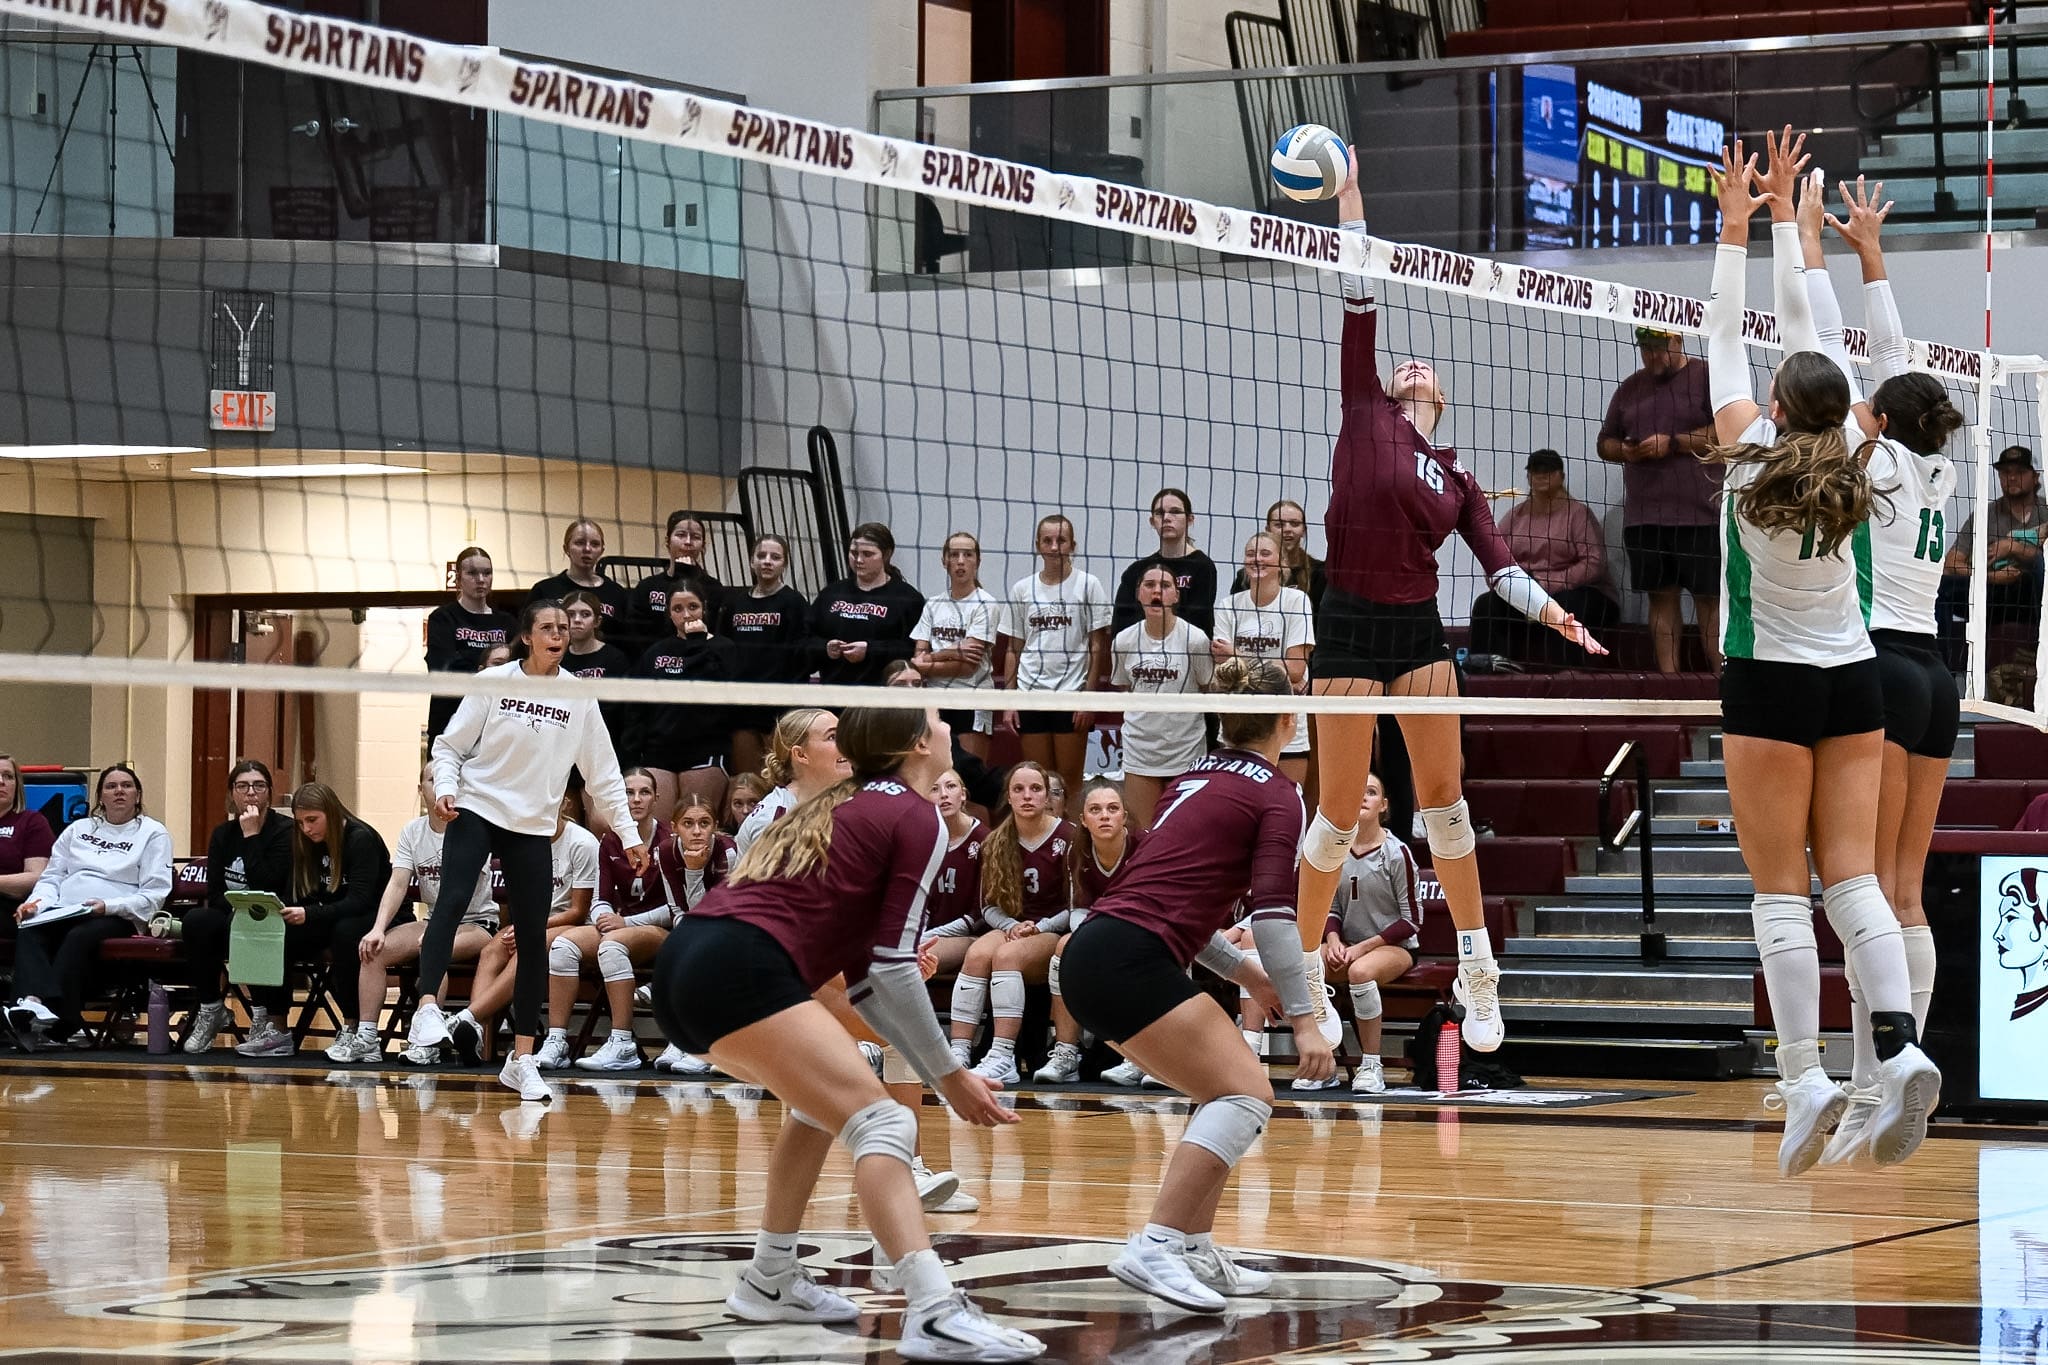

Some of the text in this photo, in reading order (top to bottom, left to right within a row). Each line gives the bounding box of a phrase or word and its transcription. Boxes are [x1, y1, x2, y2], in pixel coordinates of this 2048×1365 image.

[265, 14, 426, 83] SPARTANS
[509, 66, 653, 128] SPARTANS
[727, 109, 853, 170] SPARTANS
[922, 149, 1035, 204] SPARTANS
[1095, 184, 1197, 236] SPARTANS
[1250, 216, 1340, 264] SPARTANS
[1390, 246, 1475, 287] SPARTANS
[1517, 268, 1592, 310] SPARTANS
[1633, 289, 1704, 328] SPARTANS
[1927, 342, 1981, 378] SPARTANS
[222, 393, 267, 427] EXIT
[1414, 451, 1445, 495] 15
[1914, 507, 1944, 563] 13
[830, 600, 888, 618] SPARTAN
[1028, 616, 1072, 627] SPARTAN
[456, 627, 507, 643] SPARTA
[1235, 635, 1280, 648] SPARTAN
[1131, 667, 1178, 680] SPARTAN
[499, 697, 571, 725] SPEARFISH
[1151, 779, 1210, 831] 7
[631, 877, 645, 902] 4
[938, 867, 957, 894] 14
[1024, 867, 1040, 894] 3
[1350, 875, 1360, 901] 1
